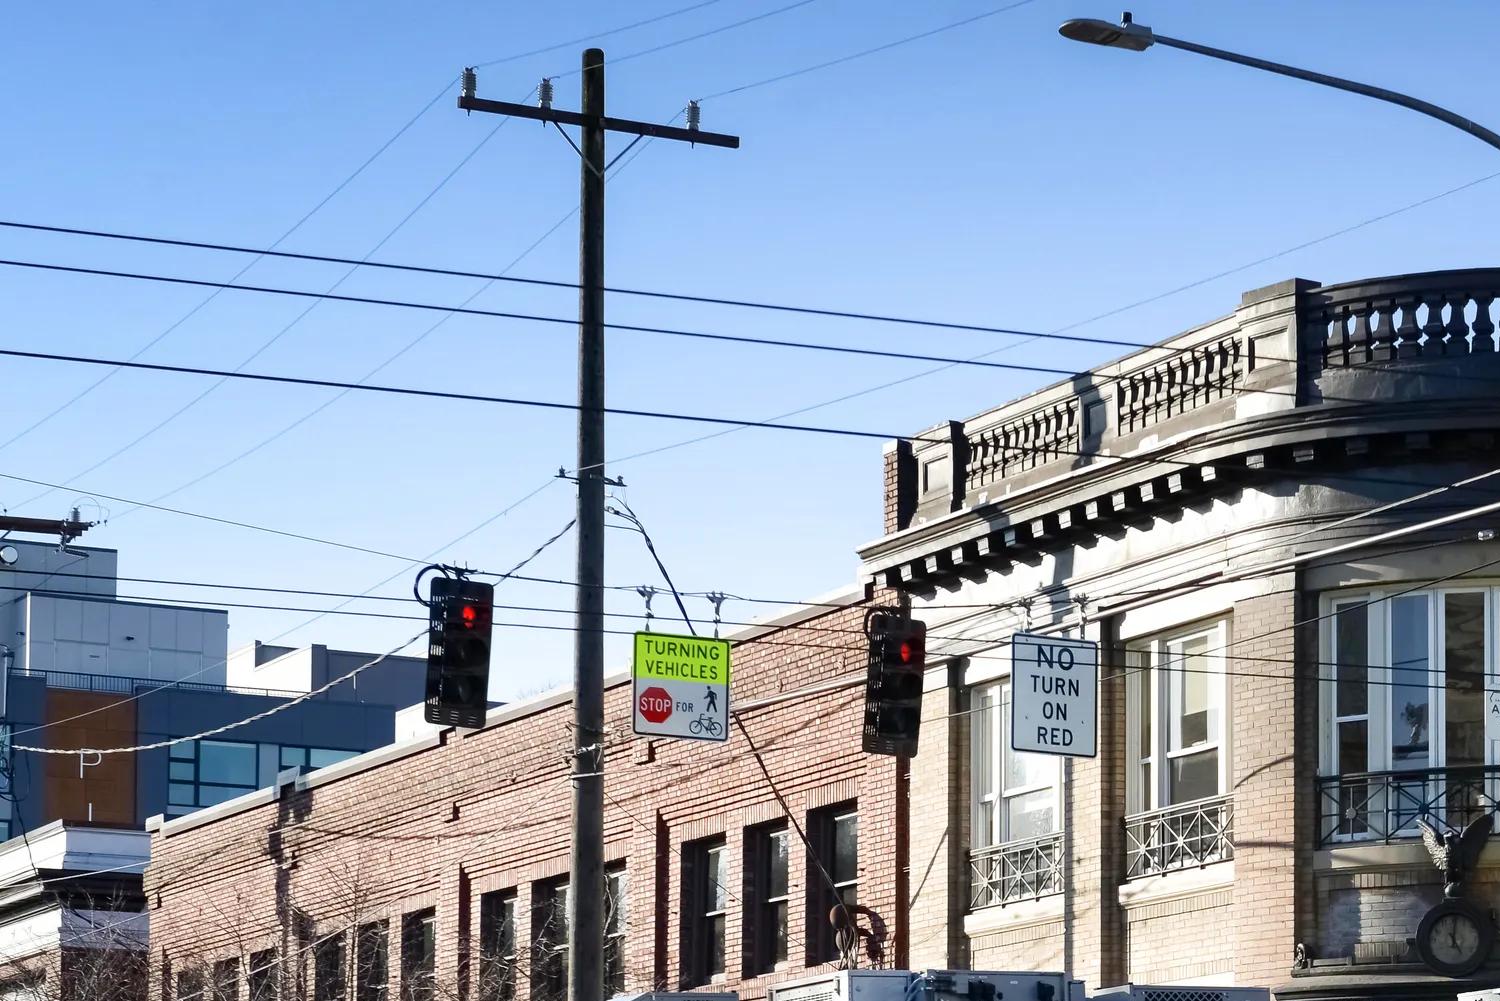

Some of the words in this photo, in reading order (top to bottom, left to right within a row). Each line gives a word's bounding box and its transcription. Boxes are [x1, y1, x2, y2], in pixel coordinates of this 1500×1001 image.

[644, 639, 720, 661] TURNING
[1037, 643, 1075, 671] NO
[645, 659, 719, 680] VEHICLES
[1030, 674, 1080, 697] TURN
[640, 697, 672, 714] STOP
[675, 701, 694, 713] FOR
[1042, 701, 1067, 721] ON
[1037, 726, 1074, 747] RED
